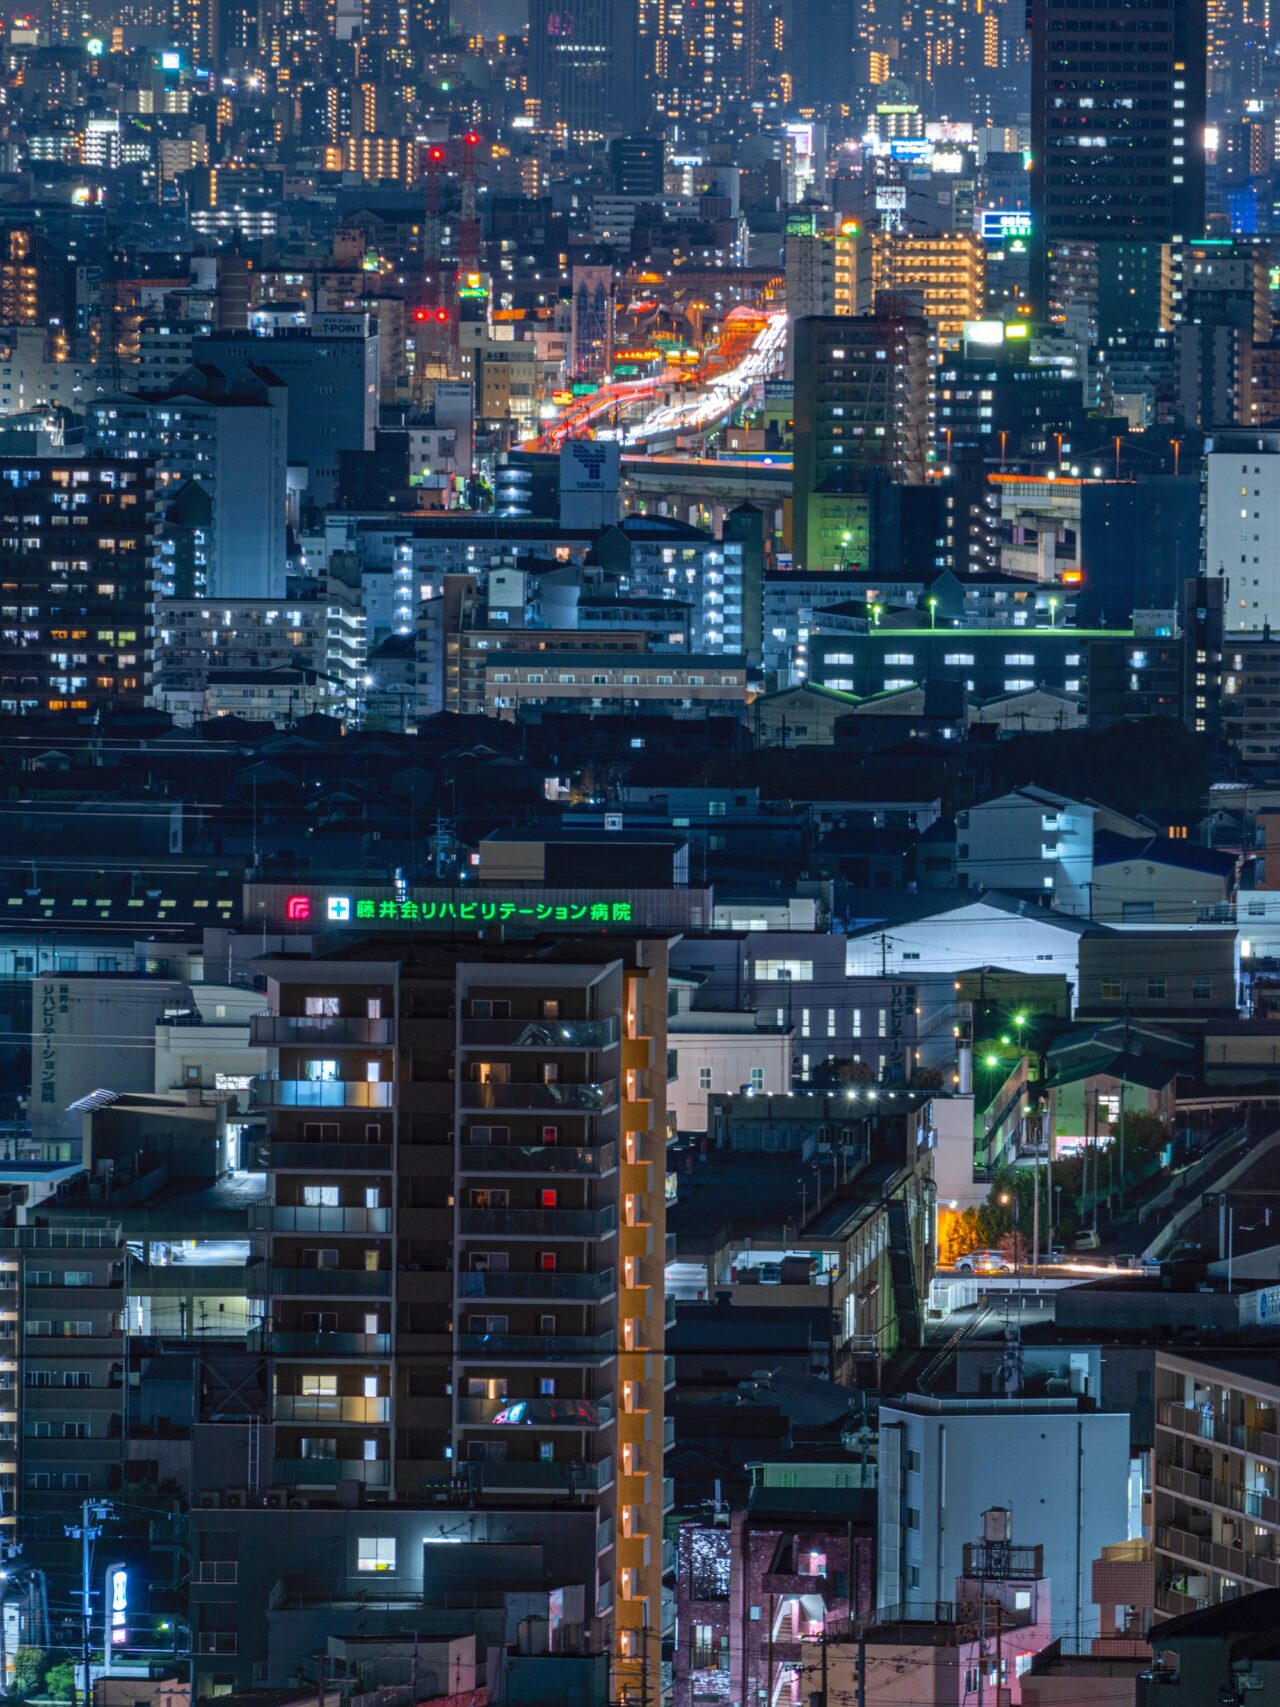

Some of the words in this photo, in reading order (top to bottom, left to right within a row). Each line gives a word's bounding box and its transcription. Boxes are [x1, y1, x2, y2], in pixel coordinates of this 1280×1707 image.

[356, 900, 632, 921] 藤井会リハビリテーション病院
[41, 984, 56, 1103] リハビリテーション病院
